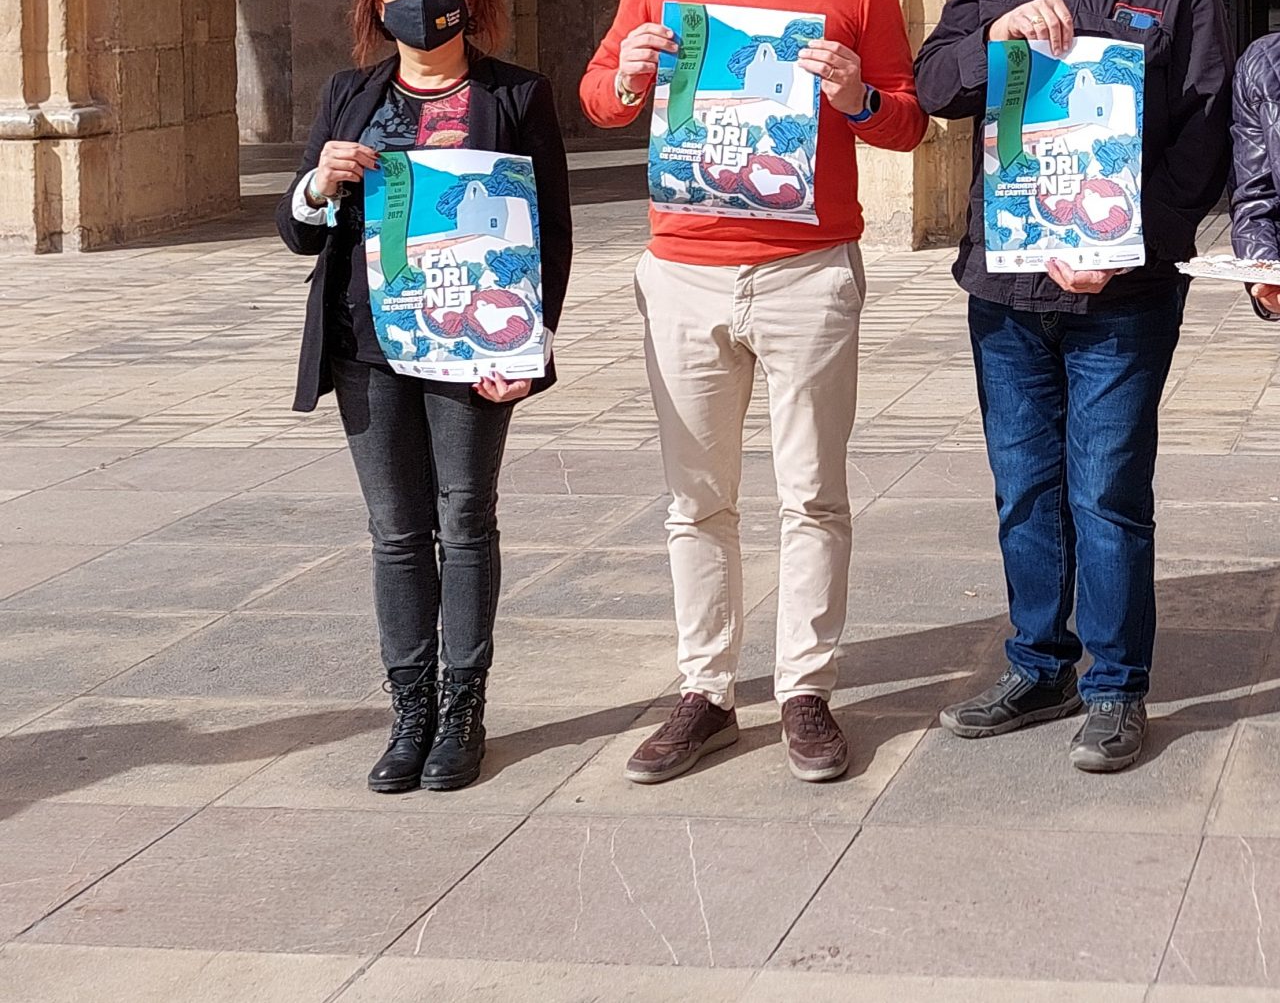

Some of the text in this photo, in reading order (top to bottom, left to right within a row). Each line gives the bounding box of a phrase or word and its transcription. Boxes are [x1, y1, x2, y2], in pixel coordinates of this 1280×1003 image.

[710, 106, 740, 126] FA
[707, 125, 749, 146] DRI
[705, 144, 753, 166] NET
[1039, 137, 1070, 156] FA
[1040, 155, 1079, 175] DRI
[1039, 174, 1084, 196] NET
[387, 211, 404, 219] 2022
[424, 249, 457, 268] FA
[426, 266, 468, 288] DRI
[425, 285, 477, 308] NET
